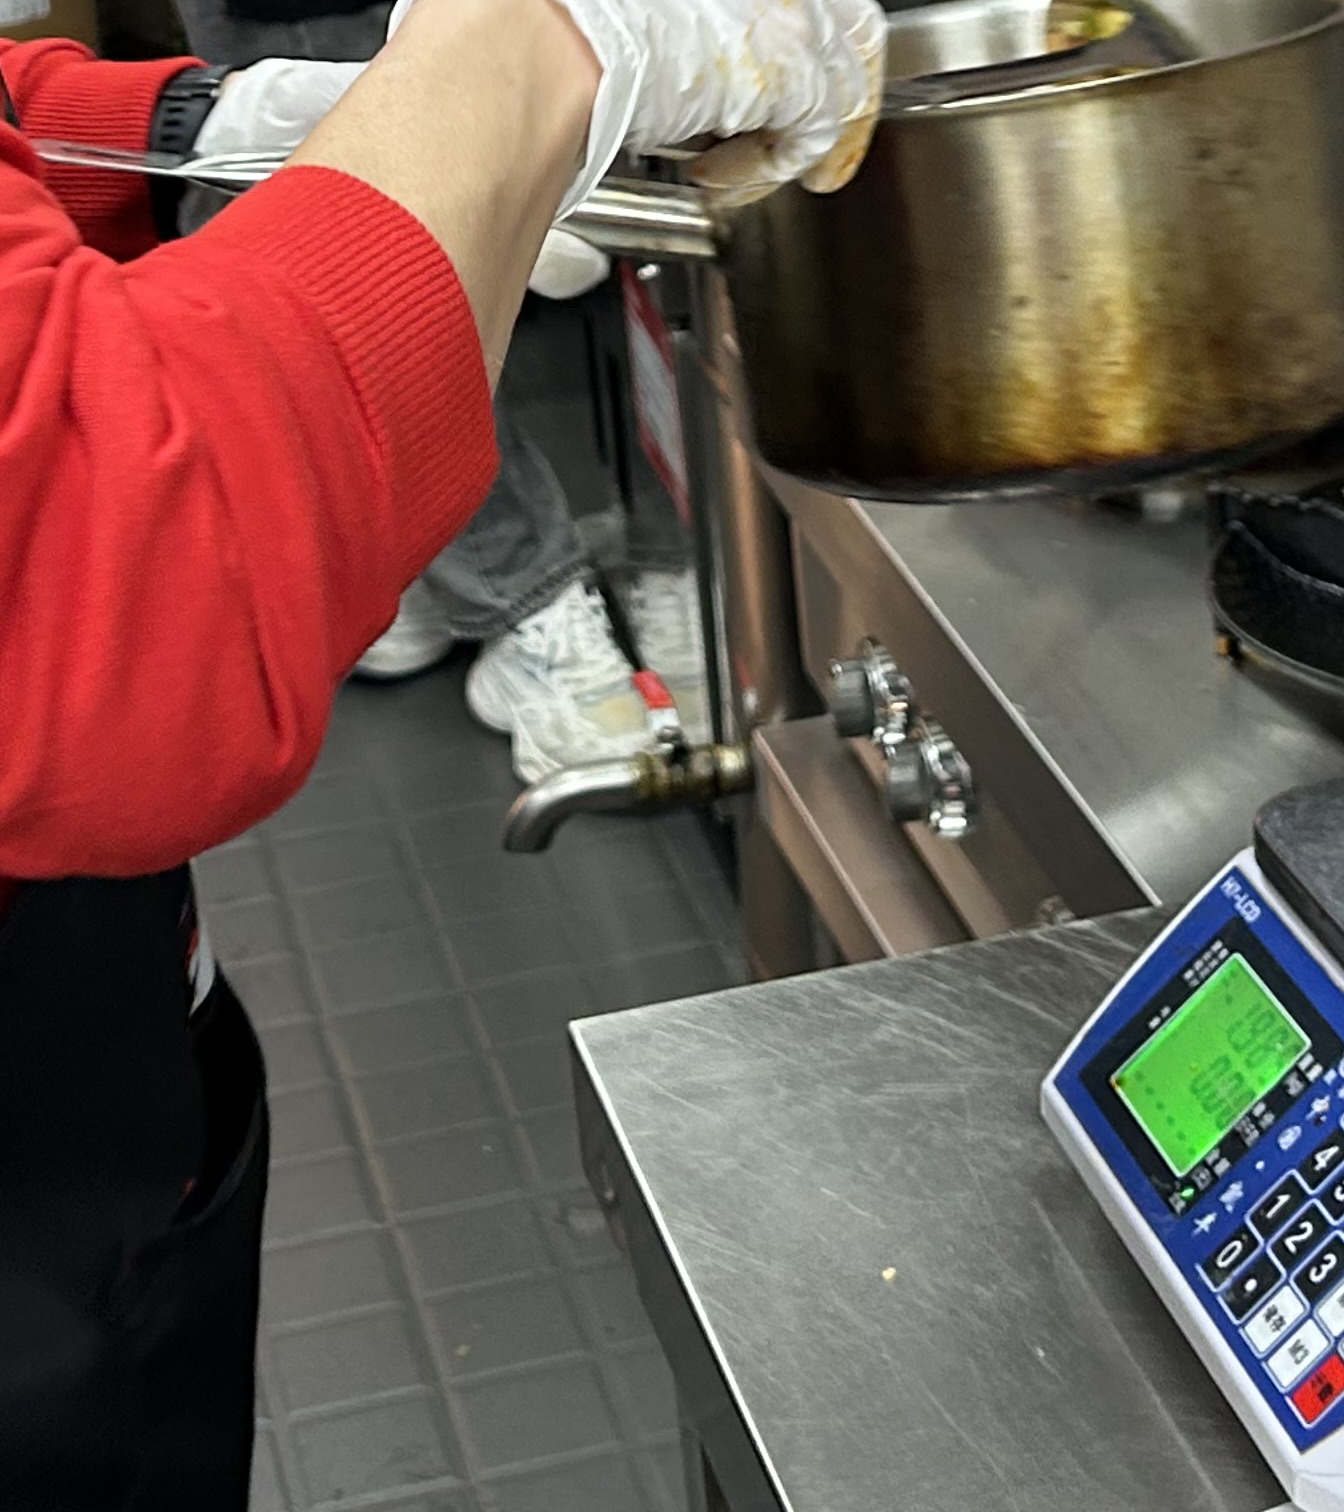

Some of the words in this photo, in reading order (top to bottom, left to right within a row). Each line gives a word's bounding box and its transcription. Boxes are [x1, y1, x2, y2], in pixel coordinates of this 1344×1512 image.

[1314, 1145, 1340, 1171] 4
[1266, 1194, 1291, 1219] 1
[1284, 1221, 1314, 1253] 2
[1309, 1253, 1337, 1283] 3
[1216, 1240, 1243, 1268] 0
[1288, 1339, 1309, 1365] M3
